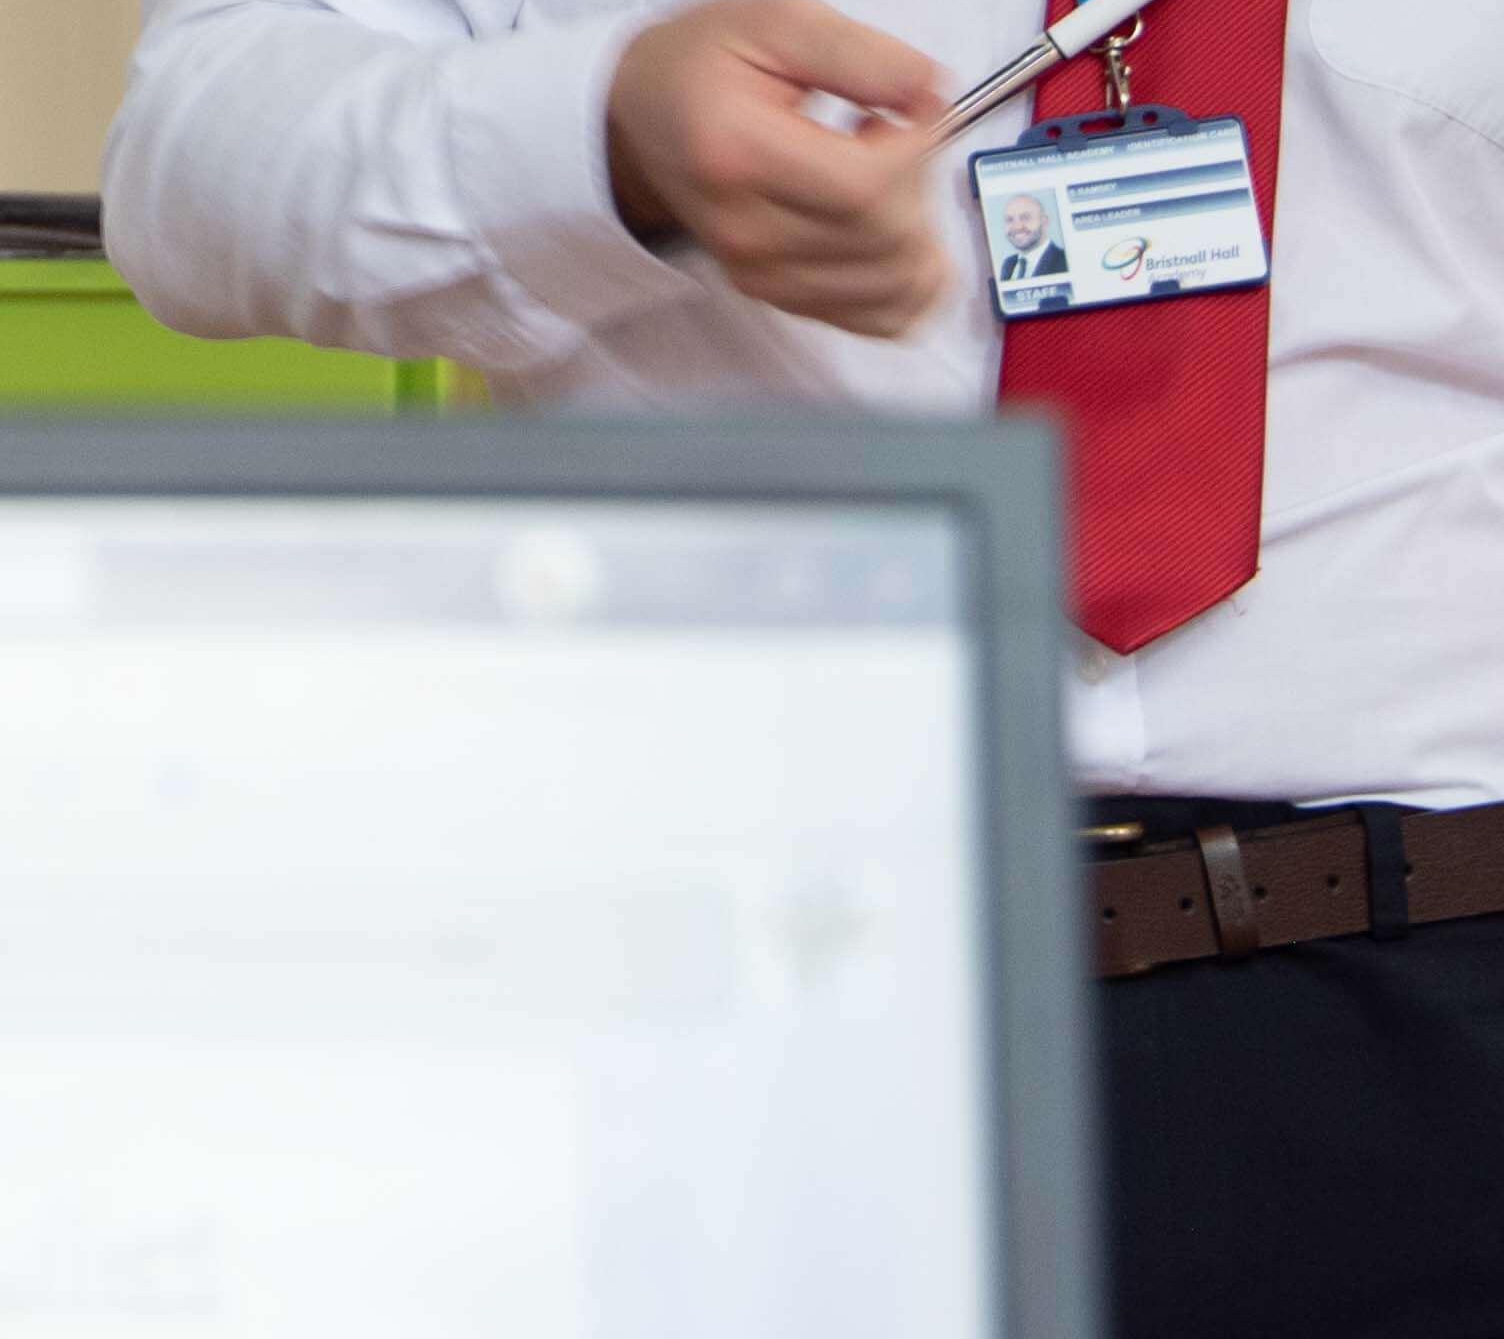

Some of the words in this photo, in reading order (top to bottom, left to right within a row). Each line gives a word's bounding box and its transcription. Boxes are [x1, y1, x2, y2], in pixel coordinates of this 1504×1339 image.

[1065, 145, 1114, 162] ACADEMY
[1126, 133, 1209, 153] IDENTIFICATION
[1102, 207, 1142, 221] LEADER
[1145, 249, 1207, 271] Bristnall
[1211, 243, 1240, 261] Hall
[1015, 286, 1058, 301] STAFF
